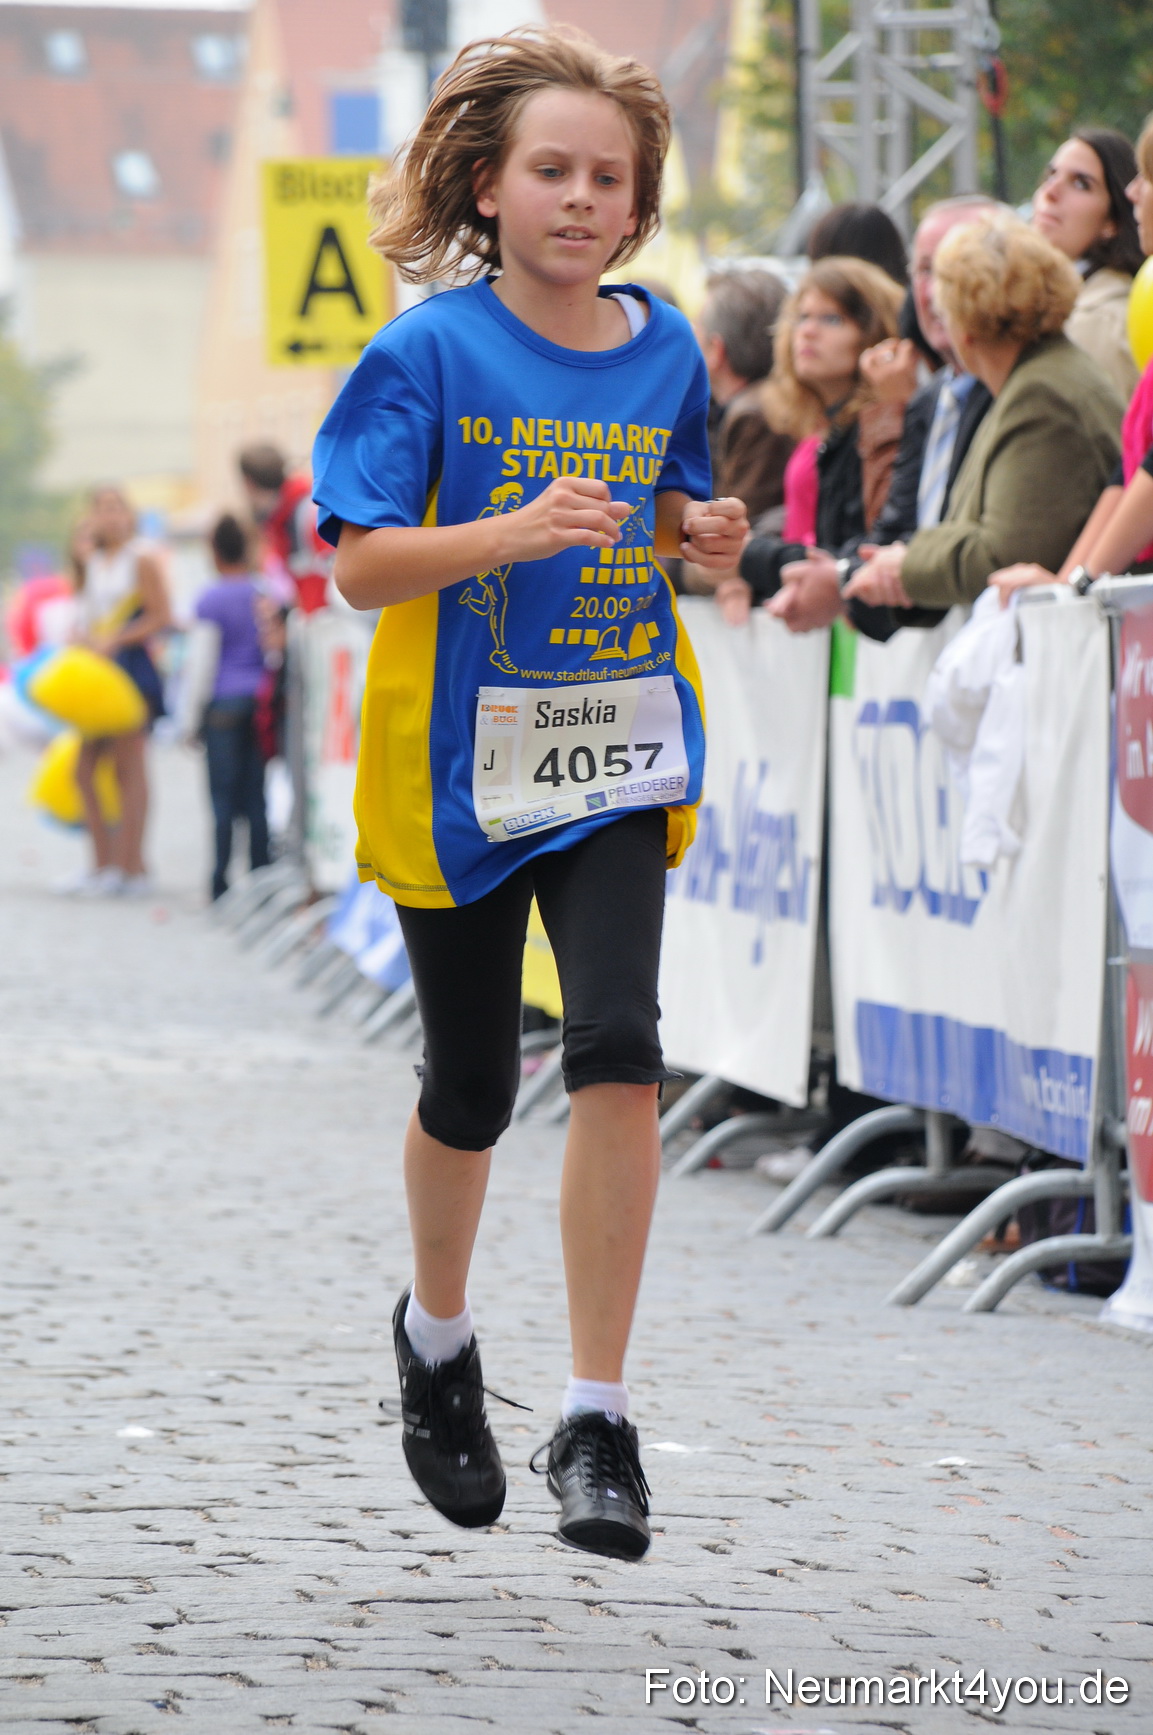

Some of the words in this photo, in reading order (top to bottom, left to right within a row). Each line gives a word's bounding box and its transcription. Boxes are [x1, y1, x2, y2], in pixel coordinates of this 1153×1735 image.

[298, 225, 366, 317] A
[457, 416, 503, 445] 10.
[501, 449, 664, 486] STADTLAUF
[520, 651, 671, 682] www.stadtlauf-neumarkt.de
[534, 697, 617, 729] Saskia
[483, 749, 495, 771] J
[533, 742, 664, 787] 4057
[608, 776, 685, 799] PFLEIDERER
[503, 806, 556, 832] BOCK
